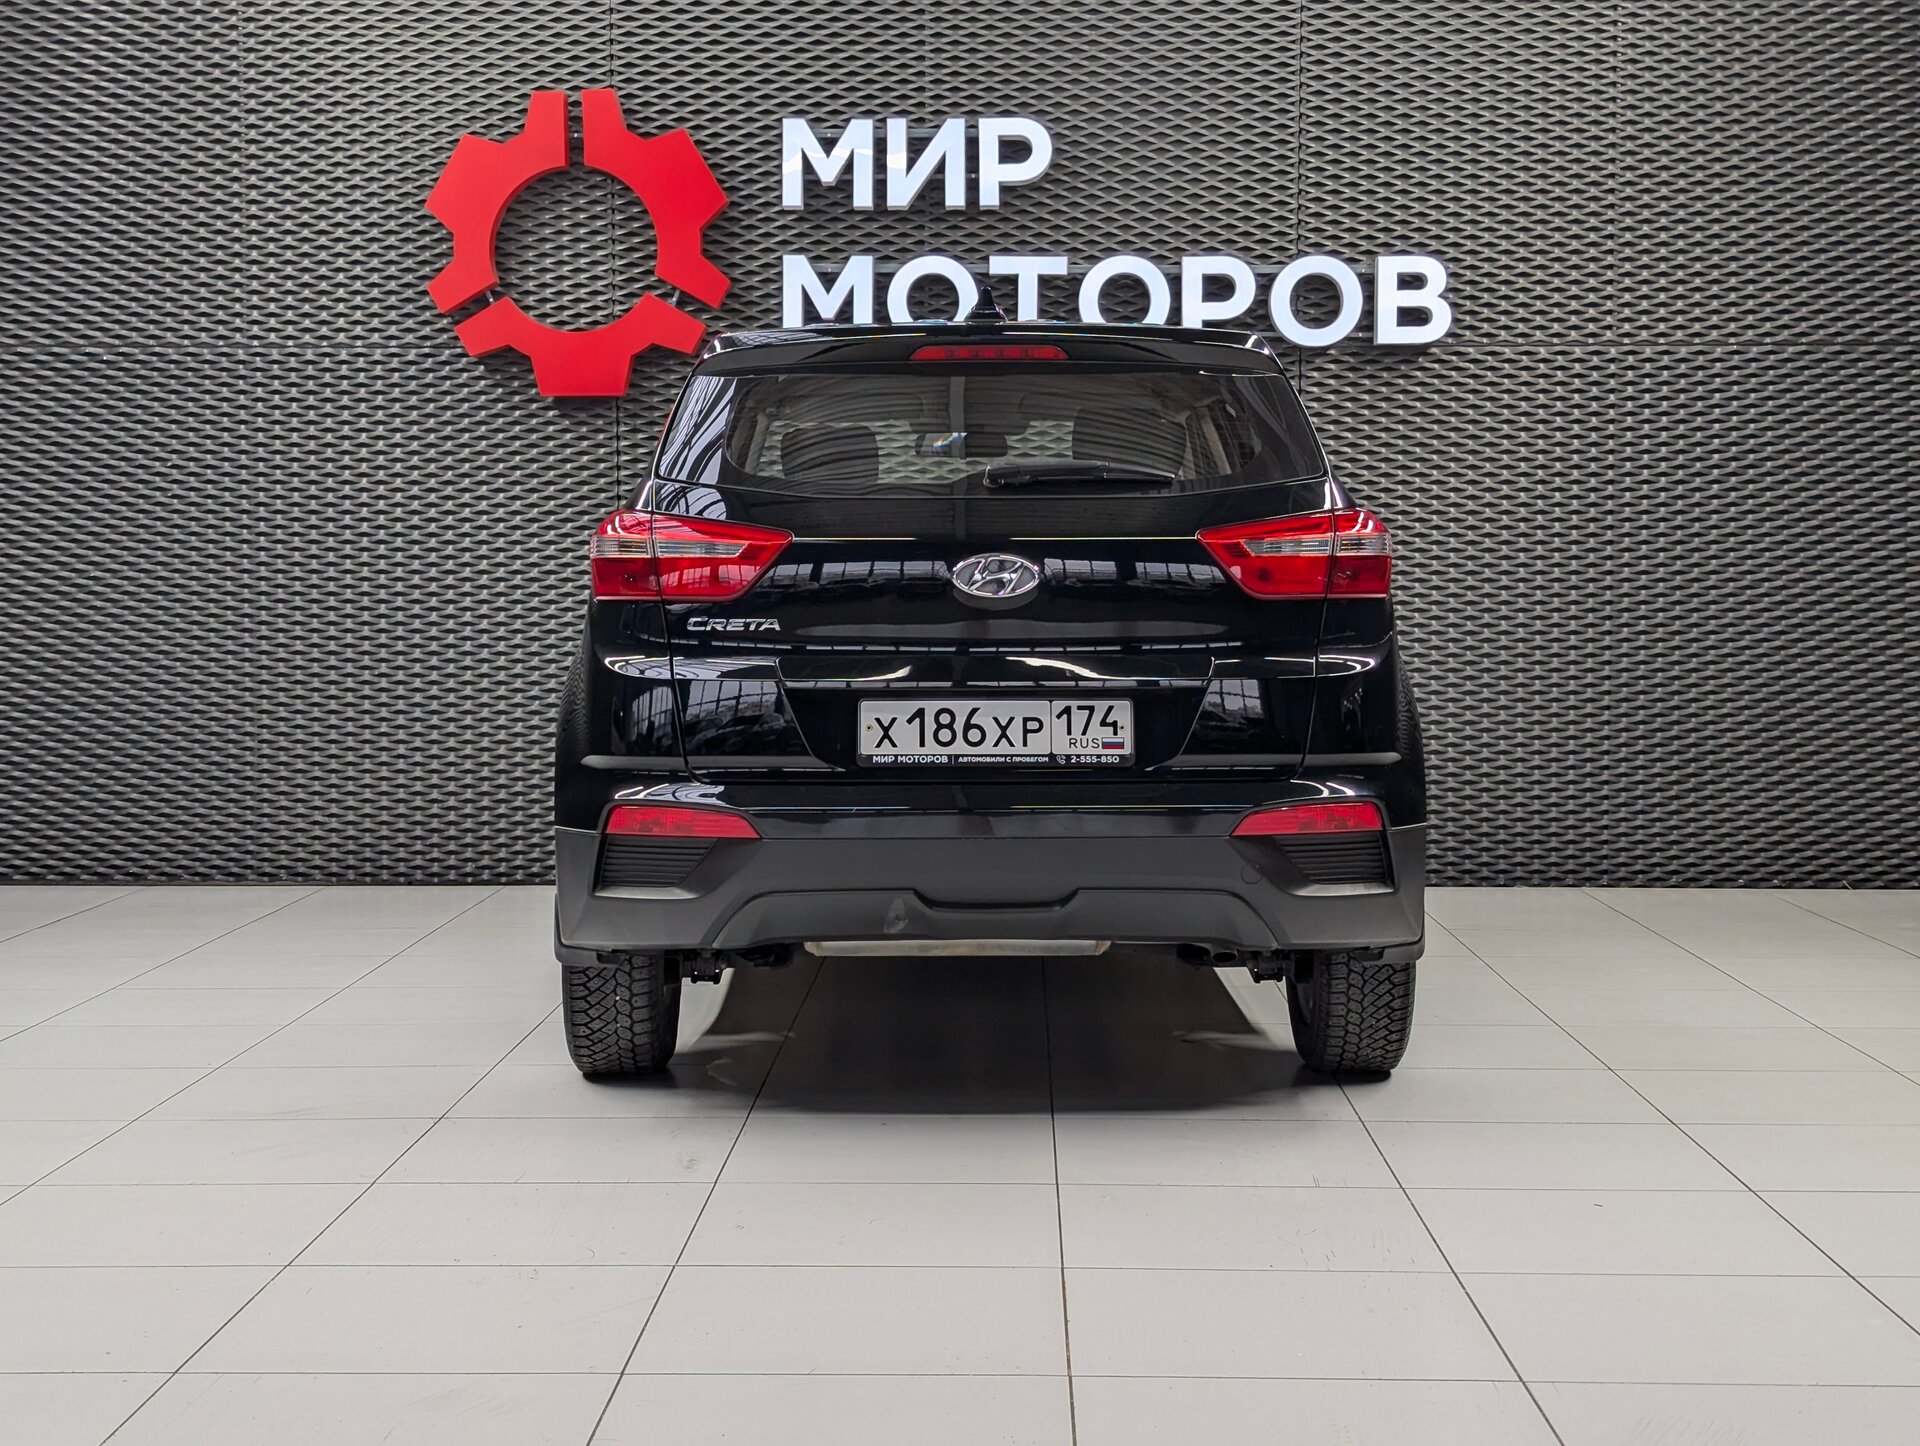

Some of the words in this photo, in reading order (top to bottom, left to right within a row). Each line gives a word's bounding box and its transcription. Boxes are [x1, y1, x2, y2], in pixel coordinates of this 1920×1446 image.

[781, 117, 1053, 211] МИР
[781, 254, 1454, 347] МОТОРОВ
[686, 616, 781, 632] CRETA
[1055, 705, 1119, 737] 174
[1068, 737, 1100, 749] RUS
[872, 755, 896, 764] МИР
[897, 755, 949, 764] МОТОРОВ
[1070, 755, 1120, 764] 2-555-850
